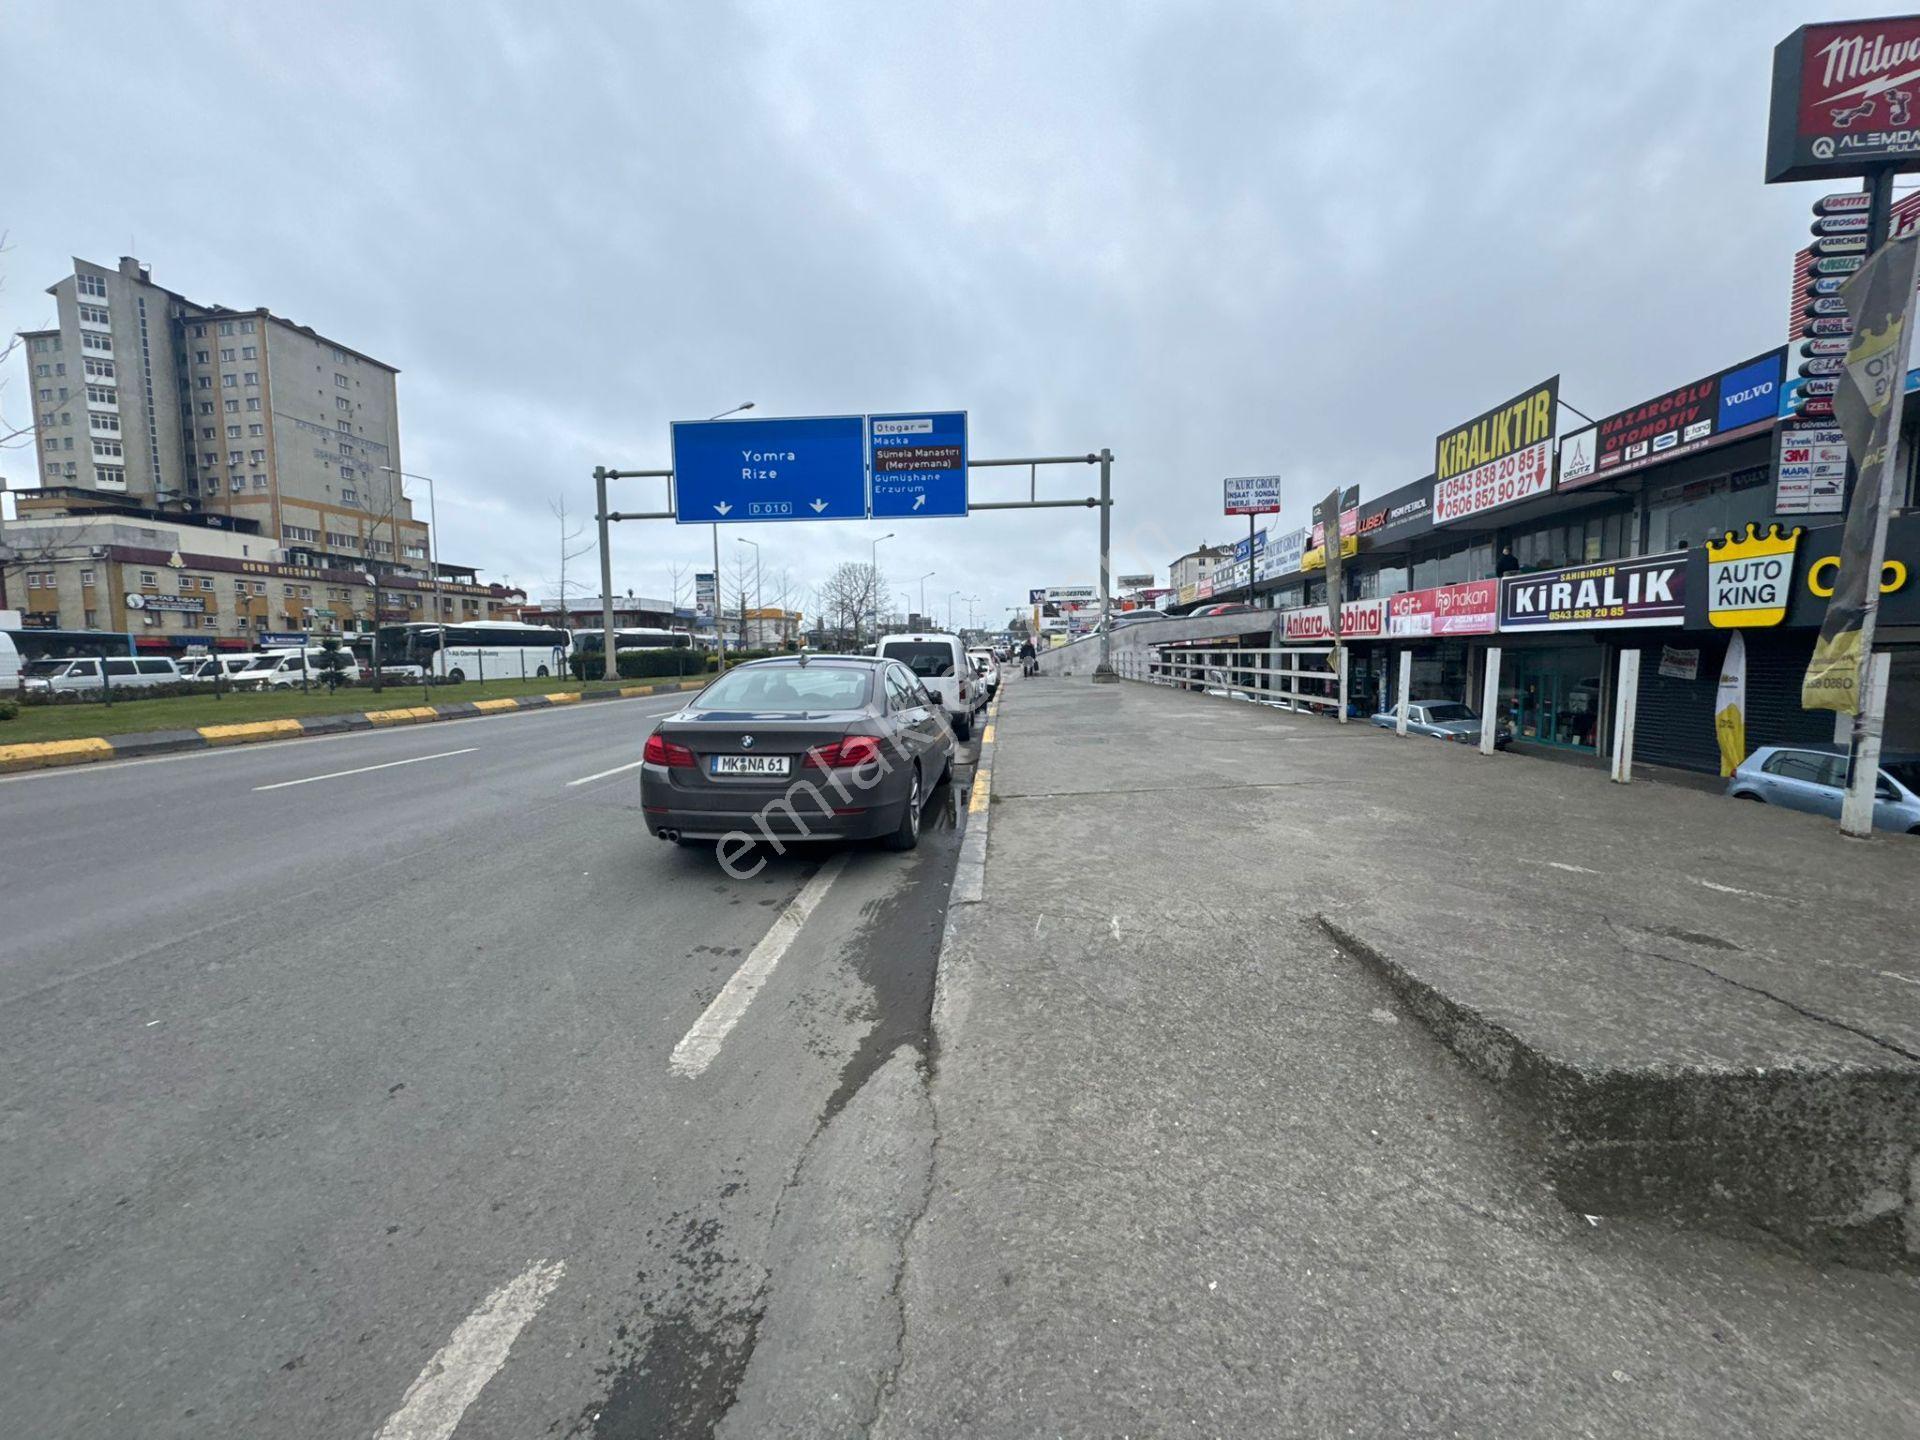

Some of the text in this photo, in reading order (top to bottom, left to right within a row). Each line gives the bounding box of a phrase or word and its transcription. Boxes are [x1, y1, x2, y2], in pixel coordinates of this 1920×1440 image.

[1825, 197, 1868, 207] LOCTITE
[1725, 381, 1773, 407] VOLVO
[876, 423, 915, 433] Otogar
[1786, 437, 1812, 445] Tyvek
[742, 450, 796, 462] Yomra
[1783, 449, 1809, 462] 3M
[742, 468, 778, 480] Rize
[1445, 448, 1535, 499] 0543 838 20 85
[1563, 464, 1591, 479] DEUTZ
[1781, 467, 1810, 475] MAPA
[874, 485, 925, 494] Erzurum
[1445, 494, 1473, 519] 0506
[1474, 485, 1496, 511] 852
[1498, 479, 1515, 502] 90
[1517, 473, 1534, 497] 27
[1357, 508, 1391, 533] LUBEX
[1717, 560, 1782, 584] AUTO
[1452, 585, 1489, 607] hakan
[1718, 584, 1777, 606] KING
[1334, 601, 1382, 635] obinaj
[1549, 605, 1625, 620] 0543 838 20 85
[1286, 614, 1322, 634] Ankara
[721, 757, 784, 772] MK NA 61
